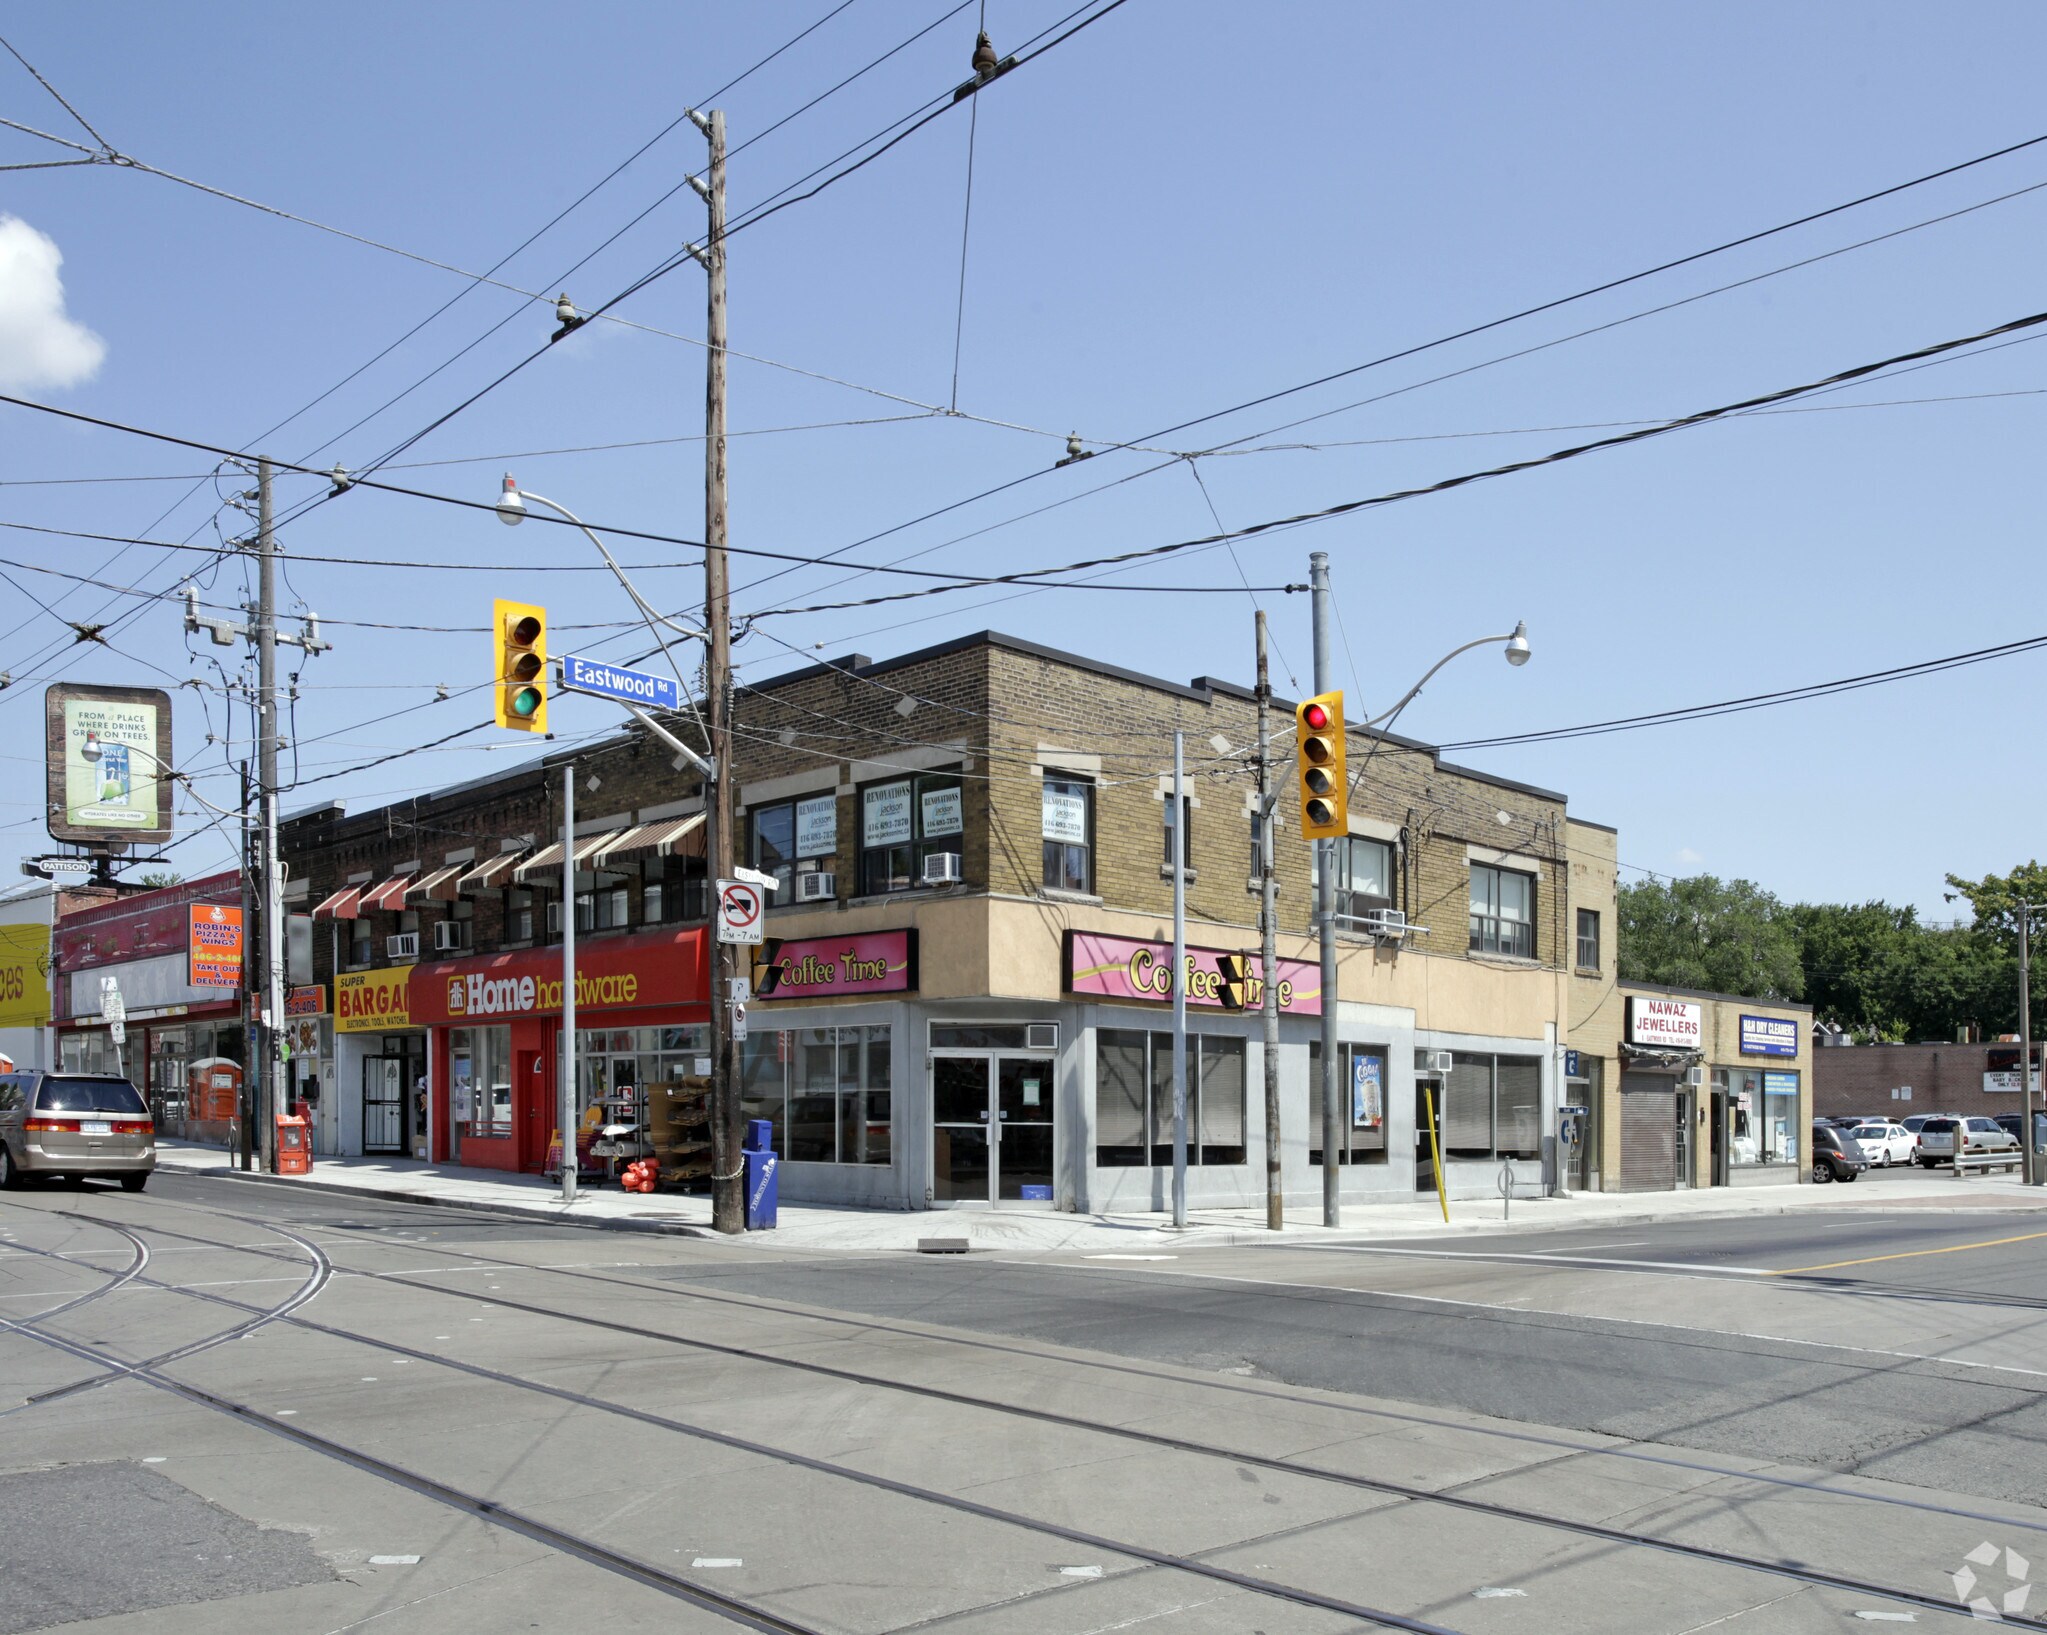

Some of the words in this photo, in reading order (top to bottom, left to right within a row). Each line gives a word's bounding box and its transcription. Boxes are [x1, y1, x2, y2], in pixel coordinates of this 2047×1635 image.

[574, 661, 654, 698] Eastwood
[657, 680, 668, 693] Rd
[78, 712, 105, 720] FROM
[117, 714, 145, 722] PLACE
[78, 721, 109, 729] WHERE
[112, 723, 146, 732] DRINKS
[122, 732, 150, 740] TREES.
[866, 785, 910, 804] RENOVATIONS
[924, 792, 959, 806] RENOVATIONS
[1043, 795, 1083, 810] RENOVATIONS
[880, 802, 903, 817] jackson
[868, 822, 880, 832] 416
[880, 818, 909, 830] 693-7870
[926, 820, 936, 828] 416
[44, 862, 87, 872] PATTISON
[194, 922, 241, 933] ROBIN'S
[196, 930, 226, 939] PIZZA
[201, 938, 236, 946] WINGS
[196, 964, 219, 972] TAKE
[779, 955, 836, 986] Coffee
[839, 948, 888, 983] Time
[196, 978, 240, 986] DELIVERY
[340, 976, 366, 988] SUPER
[466, 973, 536, 1016] Home
[536, 970, 638, 1009] hadware
[1648, 1001, 1687, 1018] NAWAZ
[1636, 1017, 1698, 1035] JEWELLERS
[1756, 1020, 1768, 1034] DRY
[1768, 1022, 1795, 1037] CLEANERS
